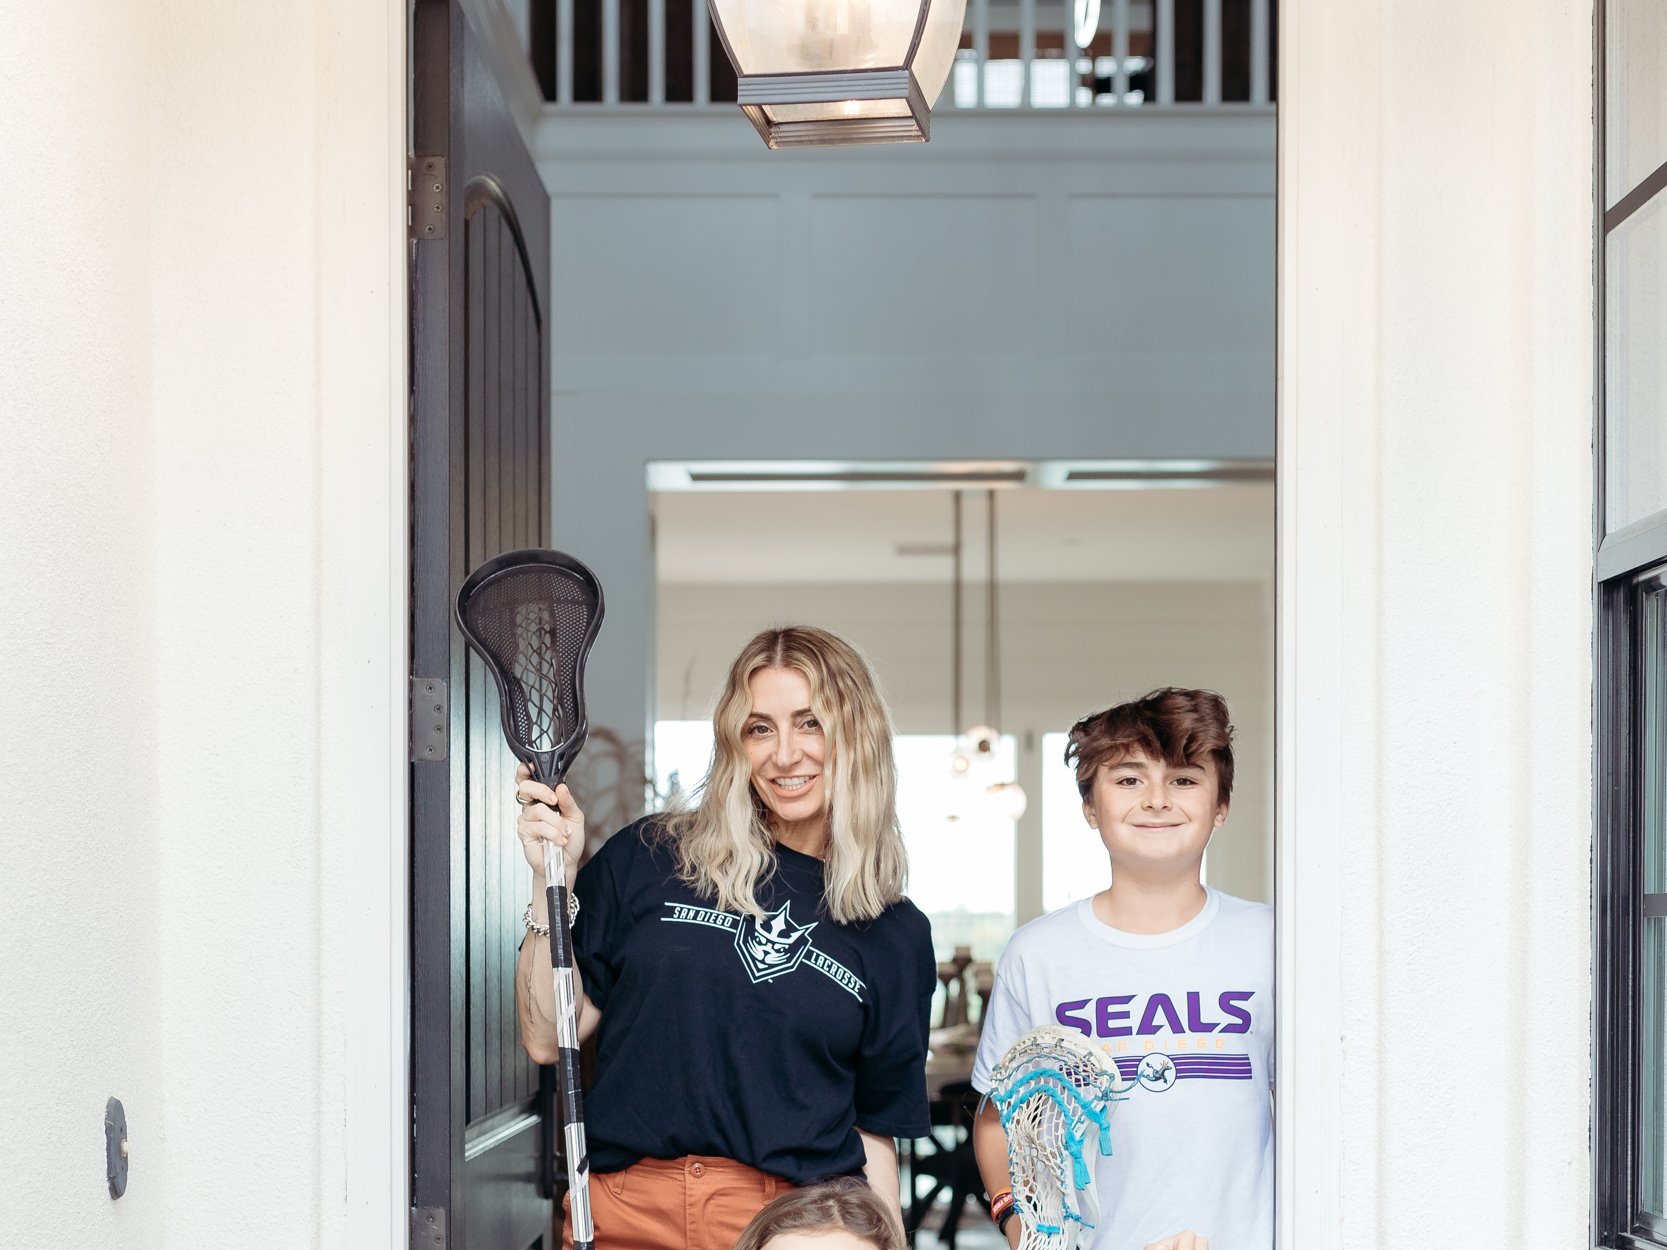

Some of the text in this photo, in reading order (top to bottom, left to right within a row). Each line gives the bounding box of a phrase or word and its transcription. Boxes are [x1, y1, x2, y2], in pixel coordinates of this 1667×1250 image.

[673, 907, 733, 927] SAN DIEGO
[811, 952, 861, 993] LACROSSE
[1056, 991, 1255, 1038] SEALS
[1144, 1038, 1224, 1051] DIEGO
